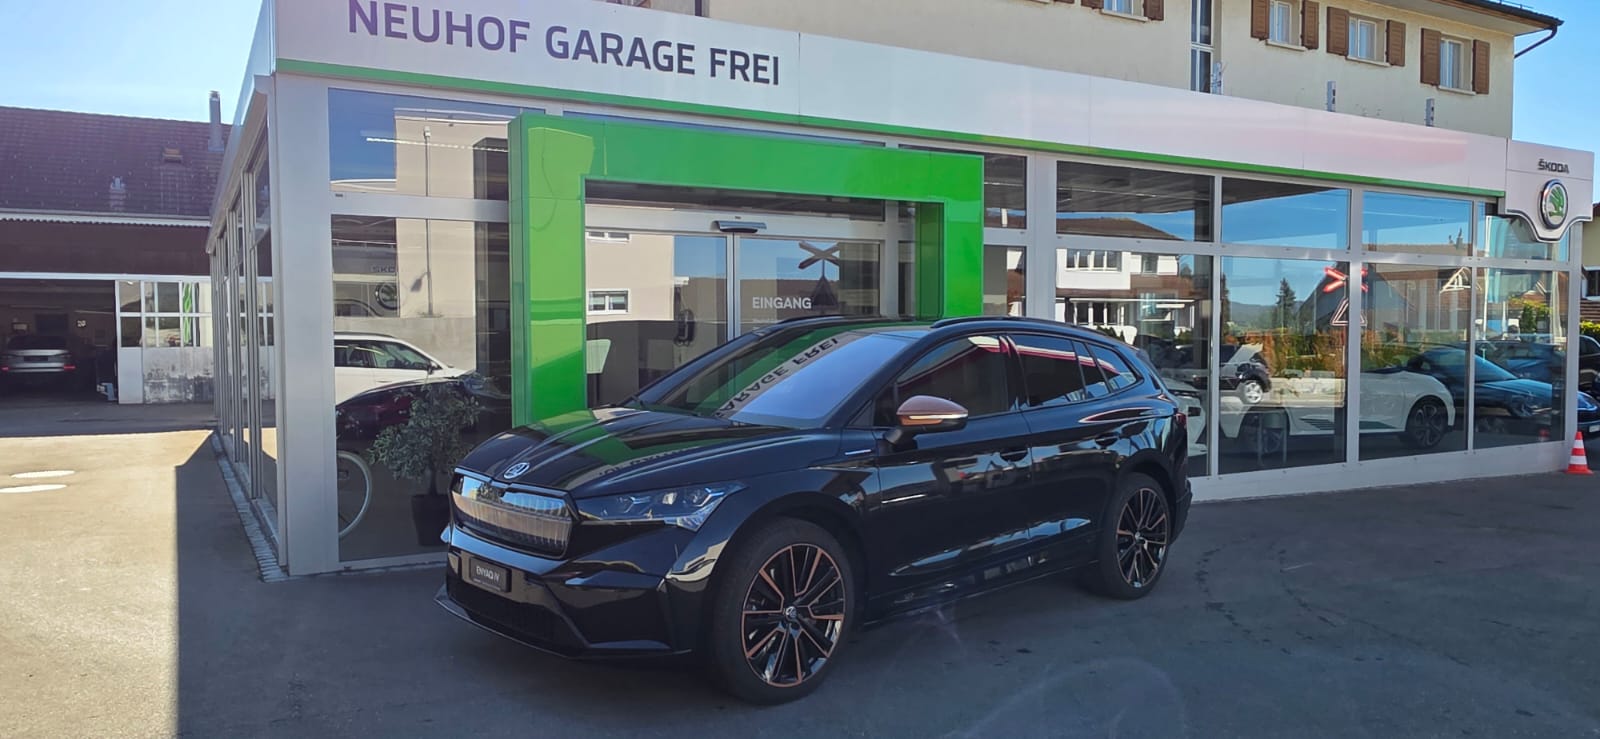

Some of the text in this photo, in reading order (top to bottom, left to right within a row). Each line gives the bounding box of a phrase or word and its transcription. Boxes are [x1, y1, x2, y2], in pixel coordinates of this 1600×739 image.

[348, 0, 780, 85] NEUHOF GARAGE FREI
[752, 296, 812, 309] EINGANG
